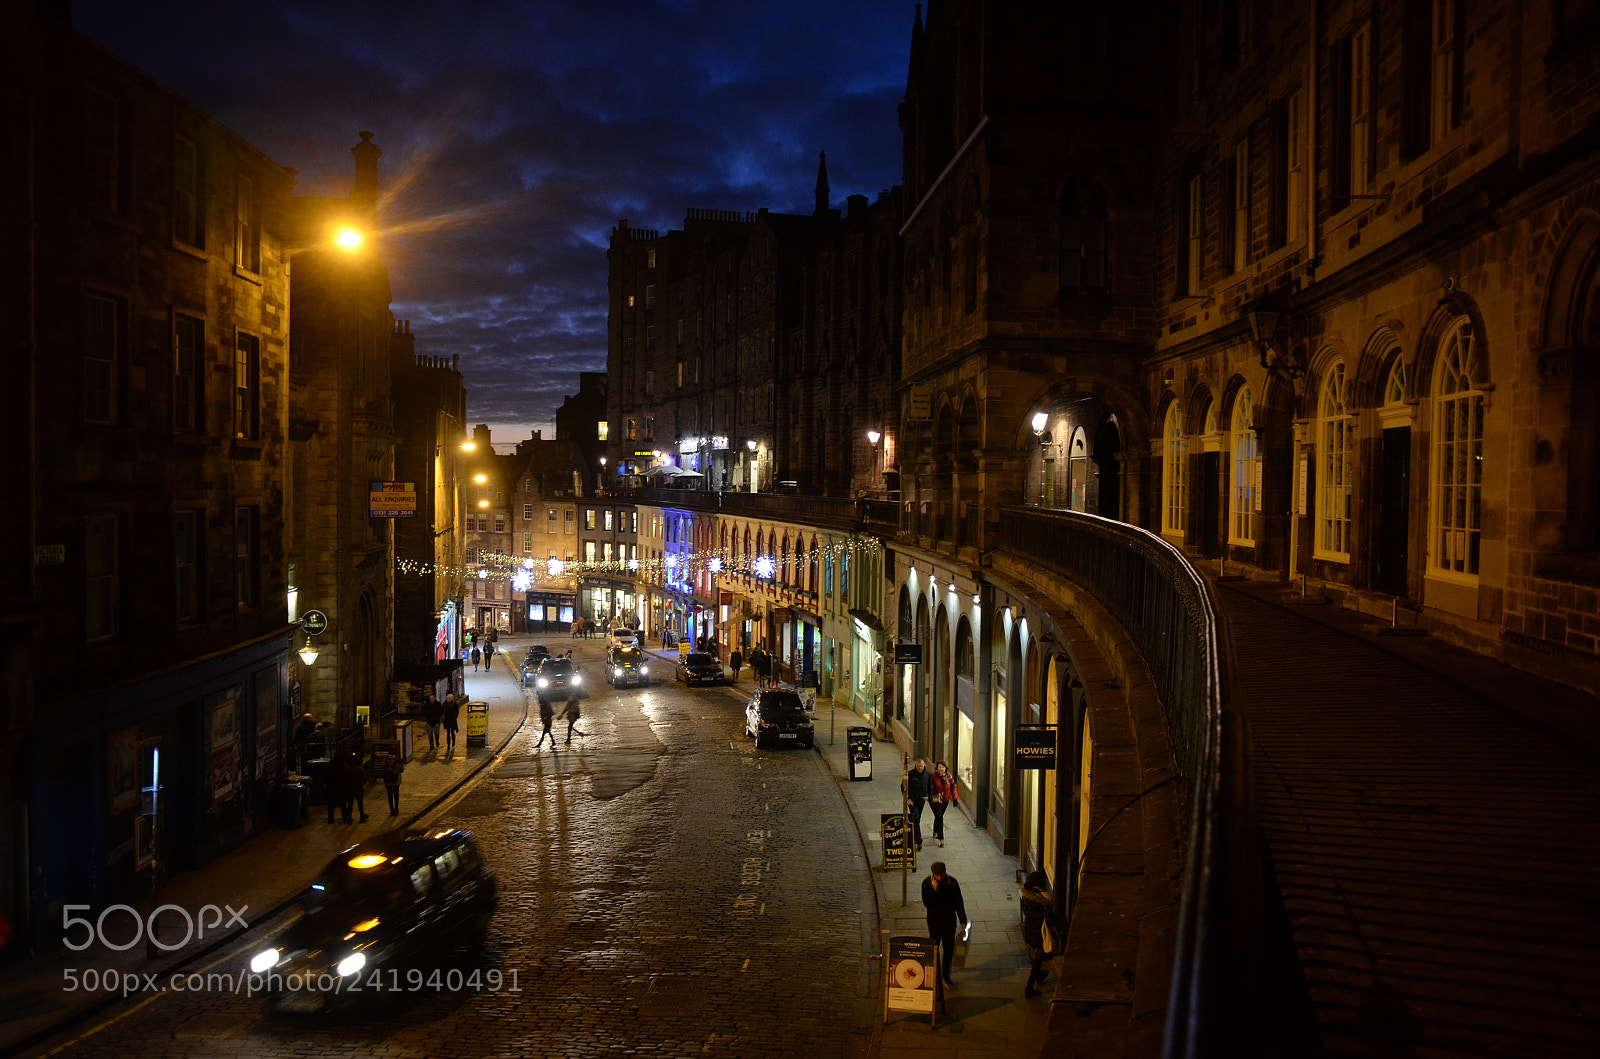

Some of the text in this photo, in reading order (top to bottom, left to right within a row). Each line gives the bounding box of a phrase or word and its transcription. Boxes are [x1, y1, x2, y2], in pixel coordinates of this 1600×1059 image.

[1016, 747, 1055, 755] HOWIES
[884, 827, 912, 839] SCOTTH
[885, 848, 912, 856] TWED
